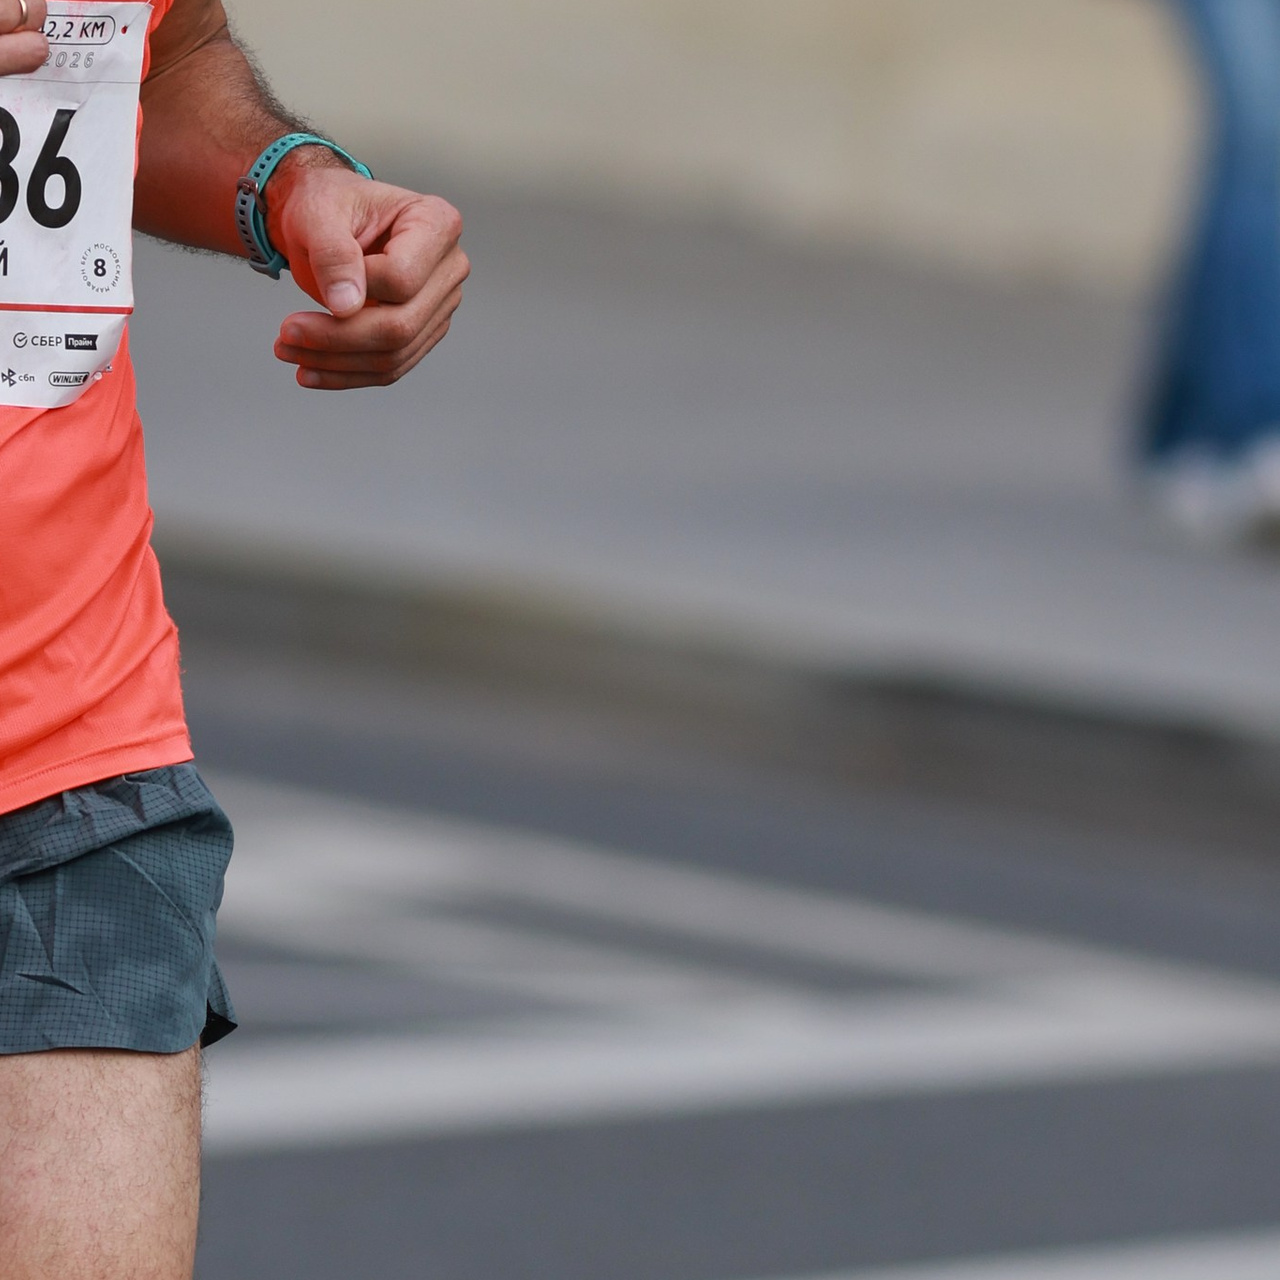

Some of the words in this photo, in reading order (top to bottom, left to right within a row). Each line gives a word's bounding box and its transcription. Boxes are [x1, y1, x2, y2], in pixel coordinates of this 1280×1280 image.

[93, 258, 107, 277] 8
[31, 335, 63, 347] СБЕР
[67, 336, 93, 348] Прайм
[52, 374, 84, 384] WINLINE
